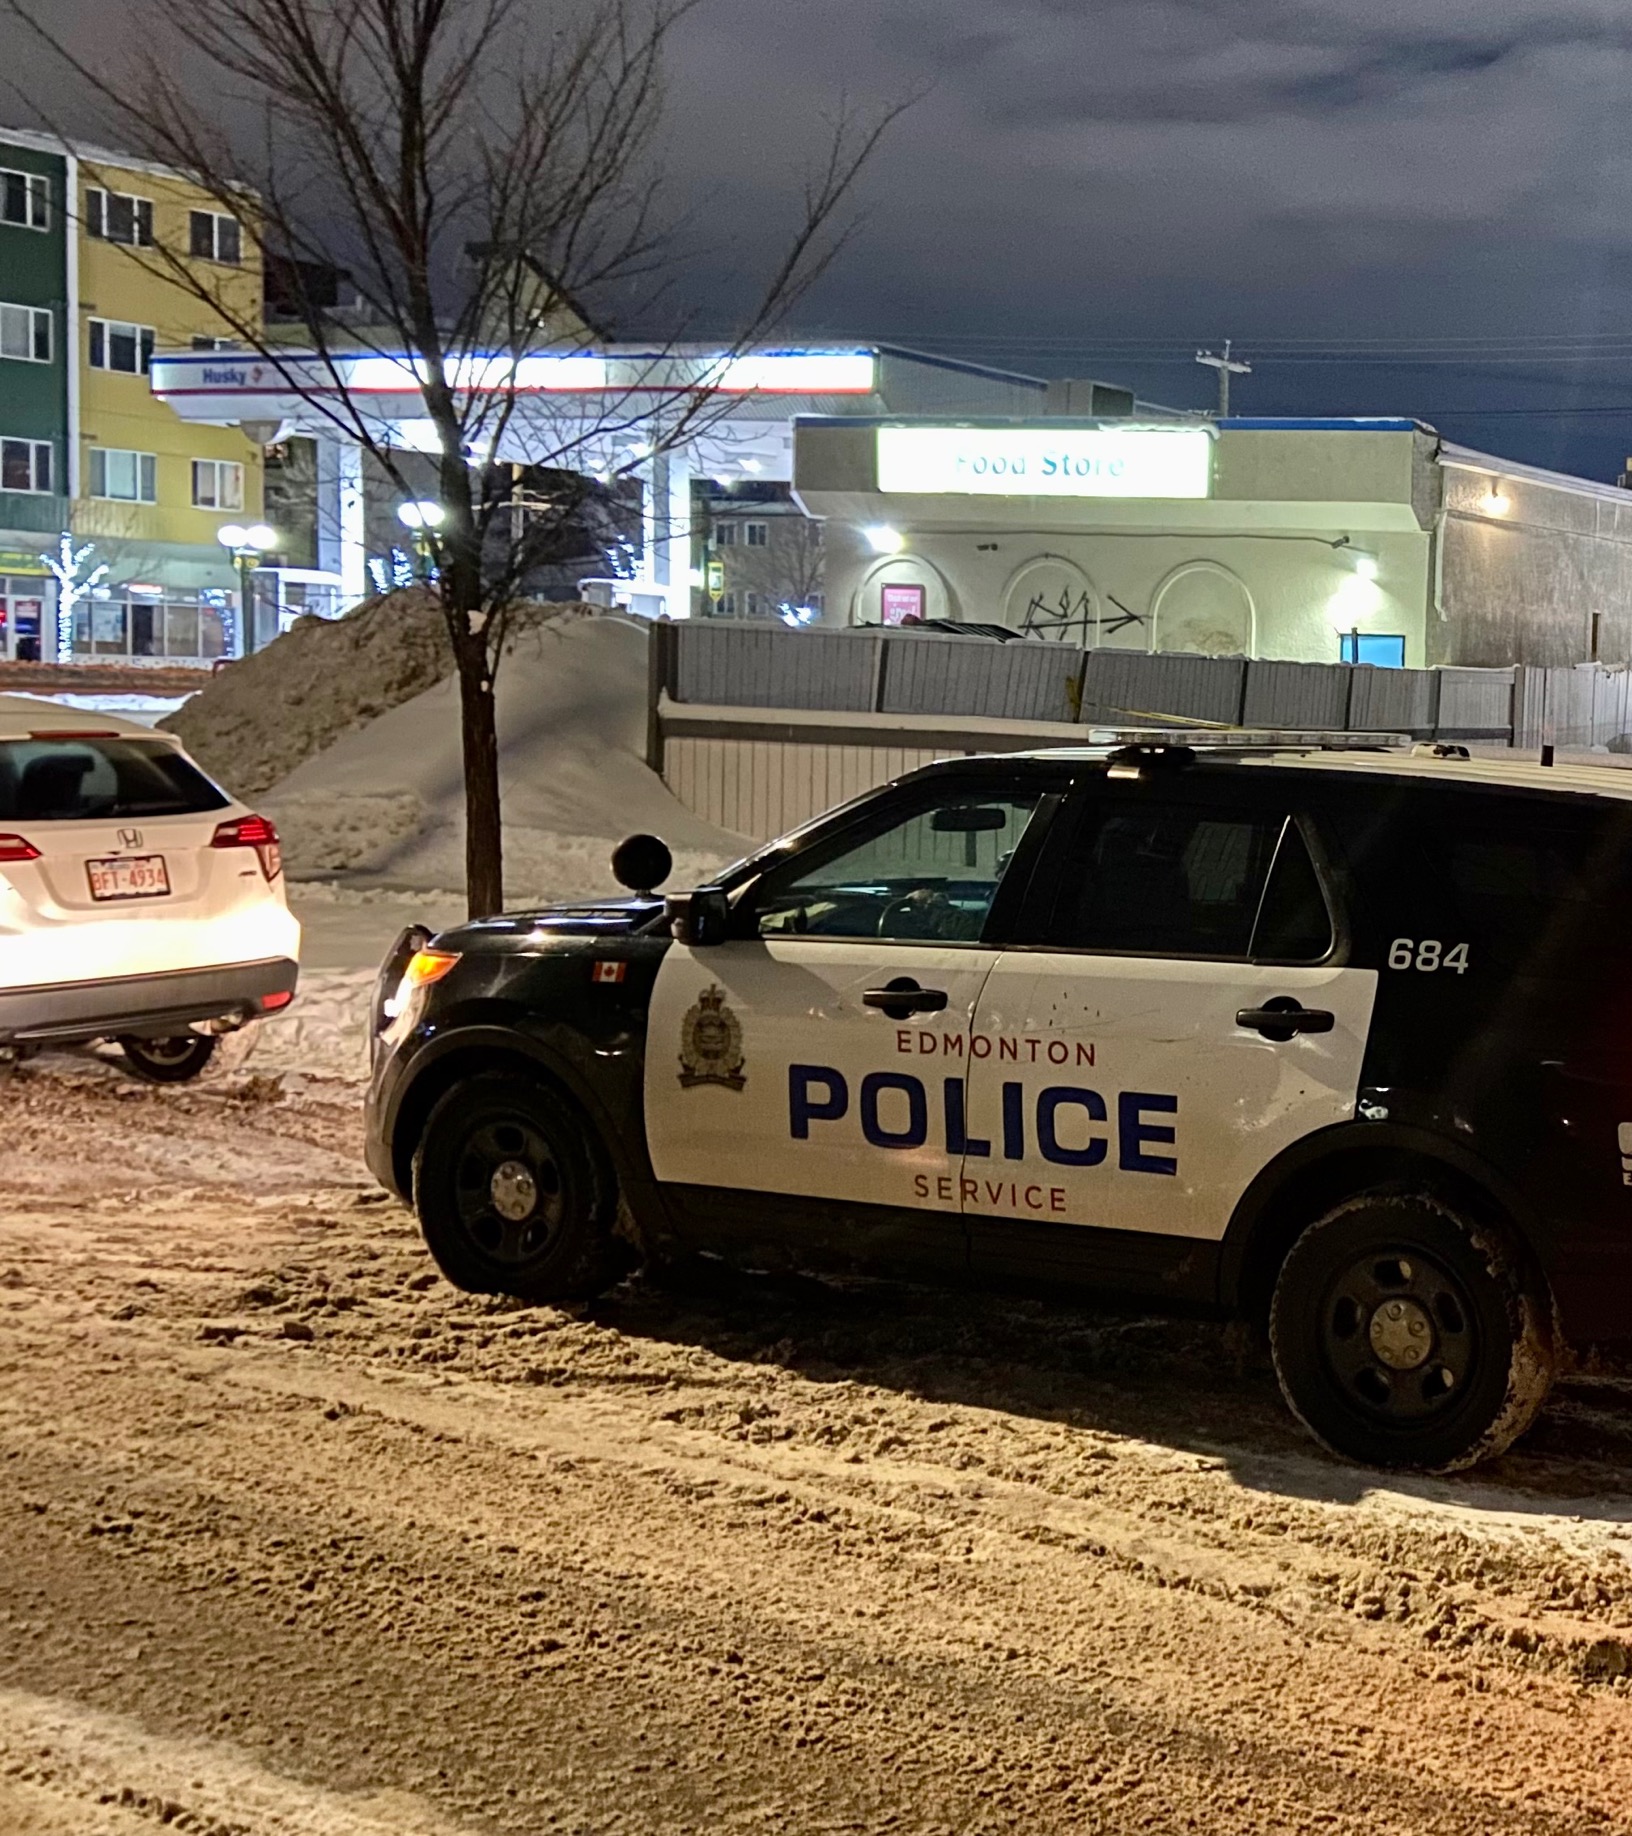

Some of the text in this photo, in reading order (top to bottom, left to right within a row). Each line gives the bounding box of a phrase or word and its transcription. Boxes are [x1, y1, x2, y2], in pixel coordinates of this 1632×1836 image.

[202, 367, 247, 386] Husky
[1040, 449, 1125, 476] Store
[1388, 938, 1469, 974] 684
[896, 1030, 1096, 1067] EDMONTON
[789, 1064, 1178, 1176] POLICE
[914, 1174, 1067, 1213] SERVICE
